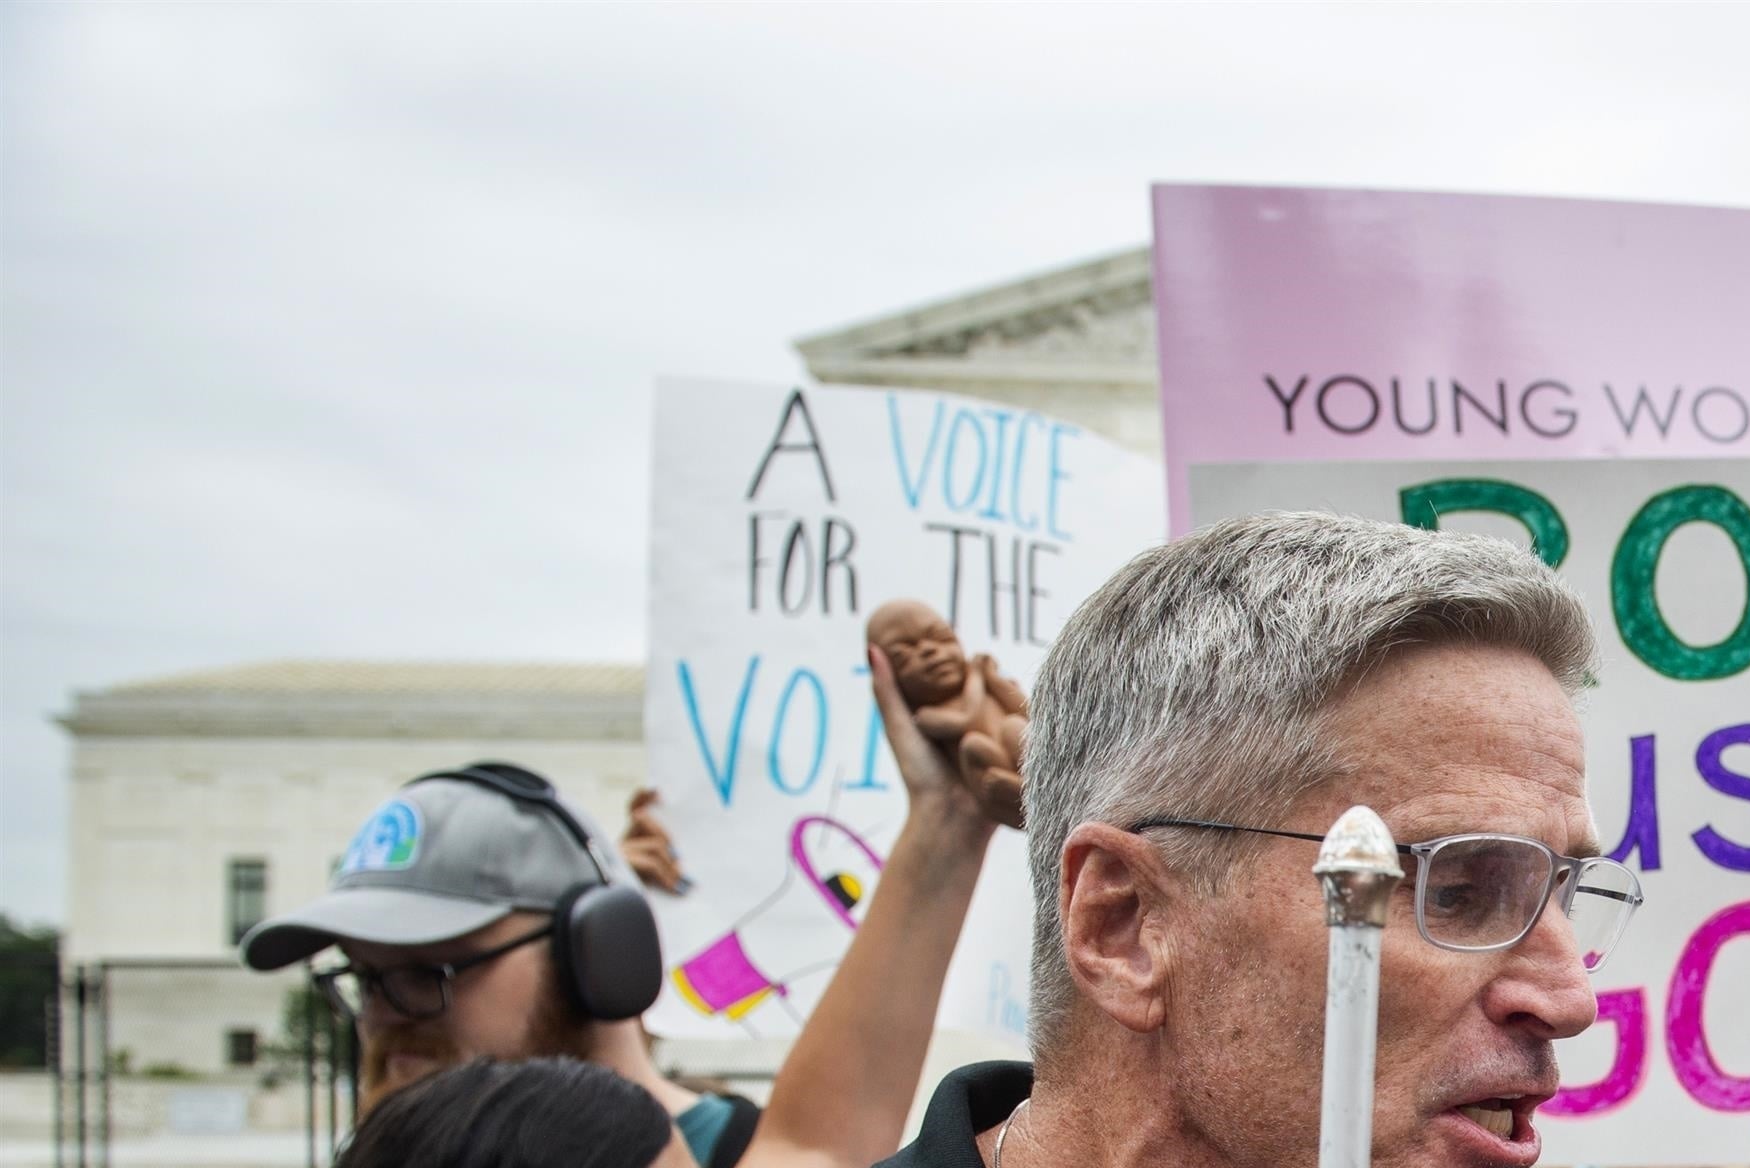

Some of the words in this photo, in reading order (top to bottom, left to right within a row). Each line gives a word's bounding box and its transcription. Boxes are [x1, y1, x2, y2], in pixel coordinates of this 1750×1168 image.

[746, 388, 837, 502] A
[887, 392, 1079, 541] VOICE
[1264, 374, 1580, 439] YOUNG
[748, 511, 860, 618] FOR
[924, 522, 1063, 649] THE
